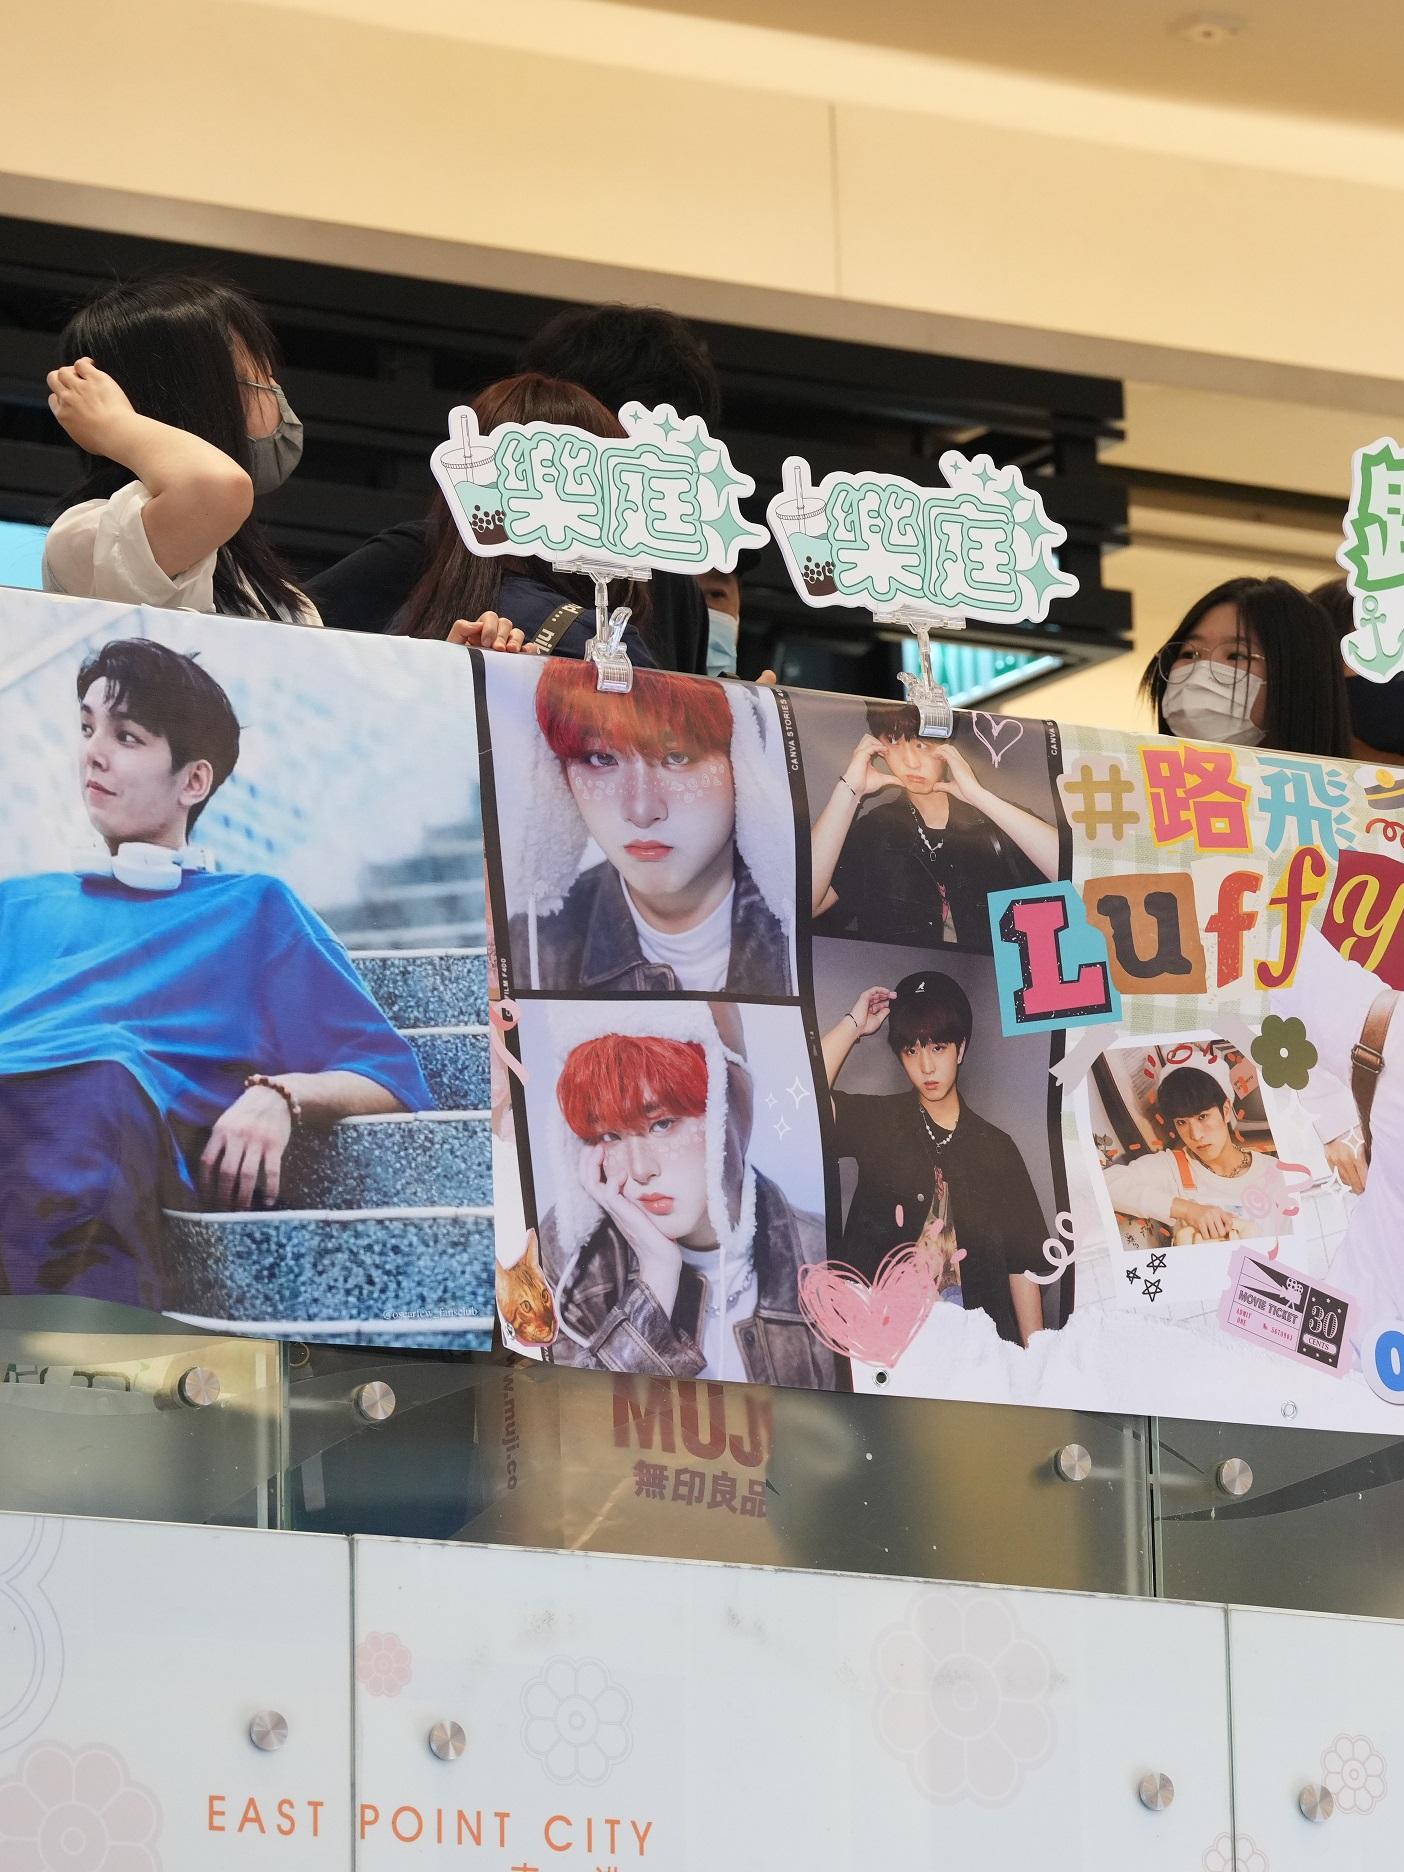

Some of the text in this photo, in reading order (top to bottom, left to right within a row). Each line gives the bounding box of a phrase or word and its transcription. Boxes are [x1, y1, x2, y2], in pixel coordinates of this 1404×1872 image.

[497, 430, 706, 562] 樂庭
[827, 482, 1022, 612] 樂庭
[780, 699, 794, 737] STORIES
[789, 740, 799, 771] CANVA
[1049, 728, 1058, 756] CANVA
[1239, 1290, 1298, 1325] MOVIE TICKET
[1309, 1305, 1338, 1339] 30
[1308, 1337, 1330, 1351] CENTS
[612, 1376, 771, 1467] MUJ
[632, 1460, 767, 1518] 無印良品
[208, 1795, 653, 1856] EAST POINT CITY
